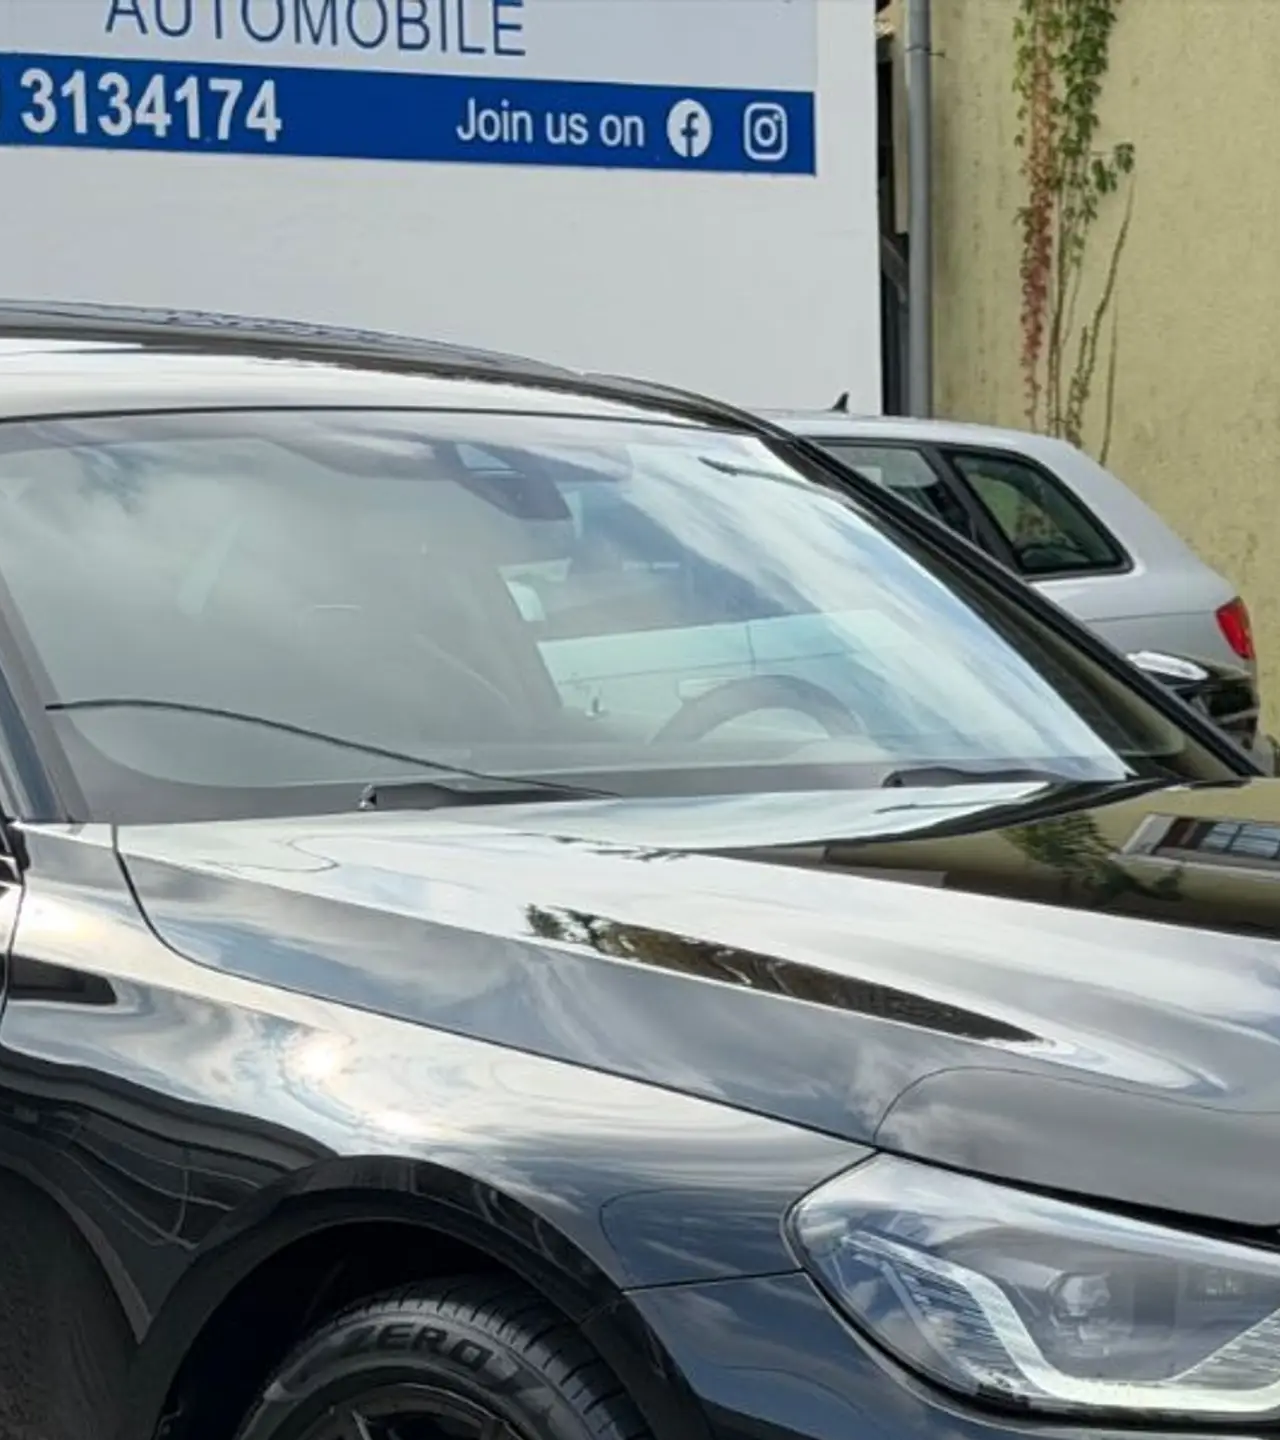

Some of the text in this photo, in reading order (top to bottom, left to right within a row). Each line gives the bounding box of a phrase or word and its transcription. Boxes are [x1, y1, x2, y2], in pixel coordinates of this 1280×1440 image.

[21, 68, 281, 141] 3134174
[456, 97, 644, 147] Join us on
